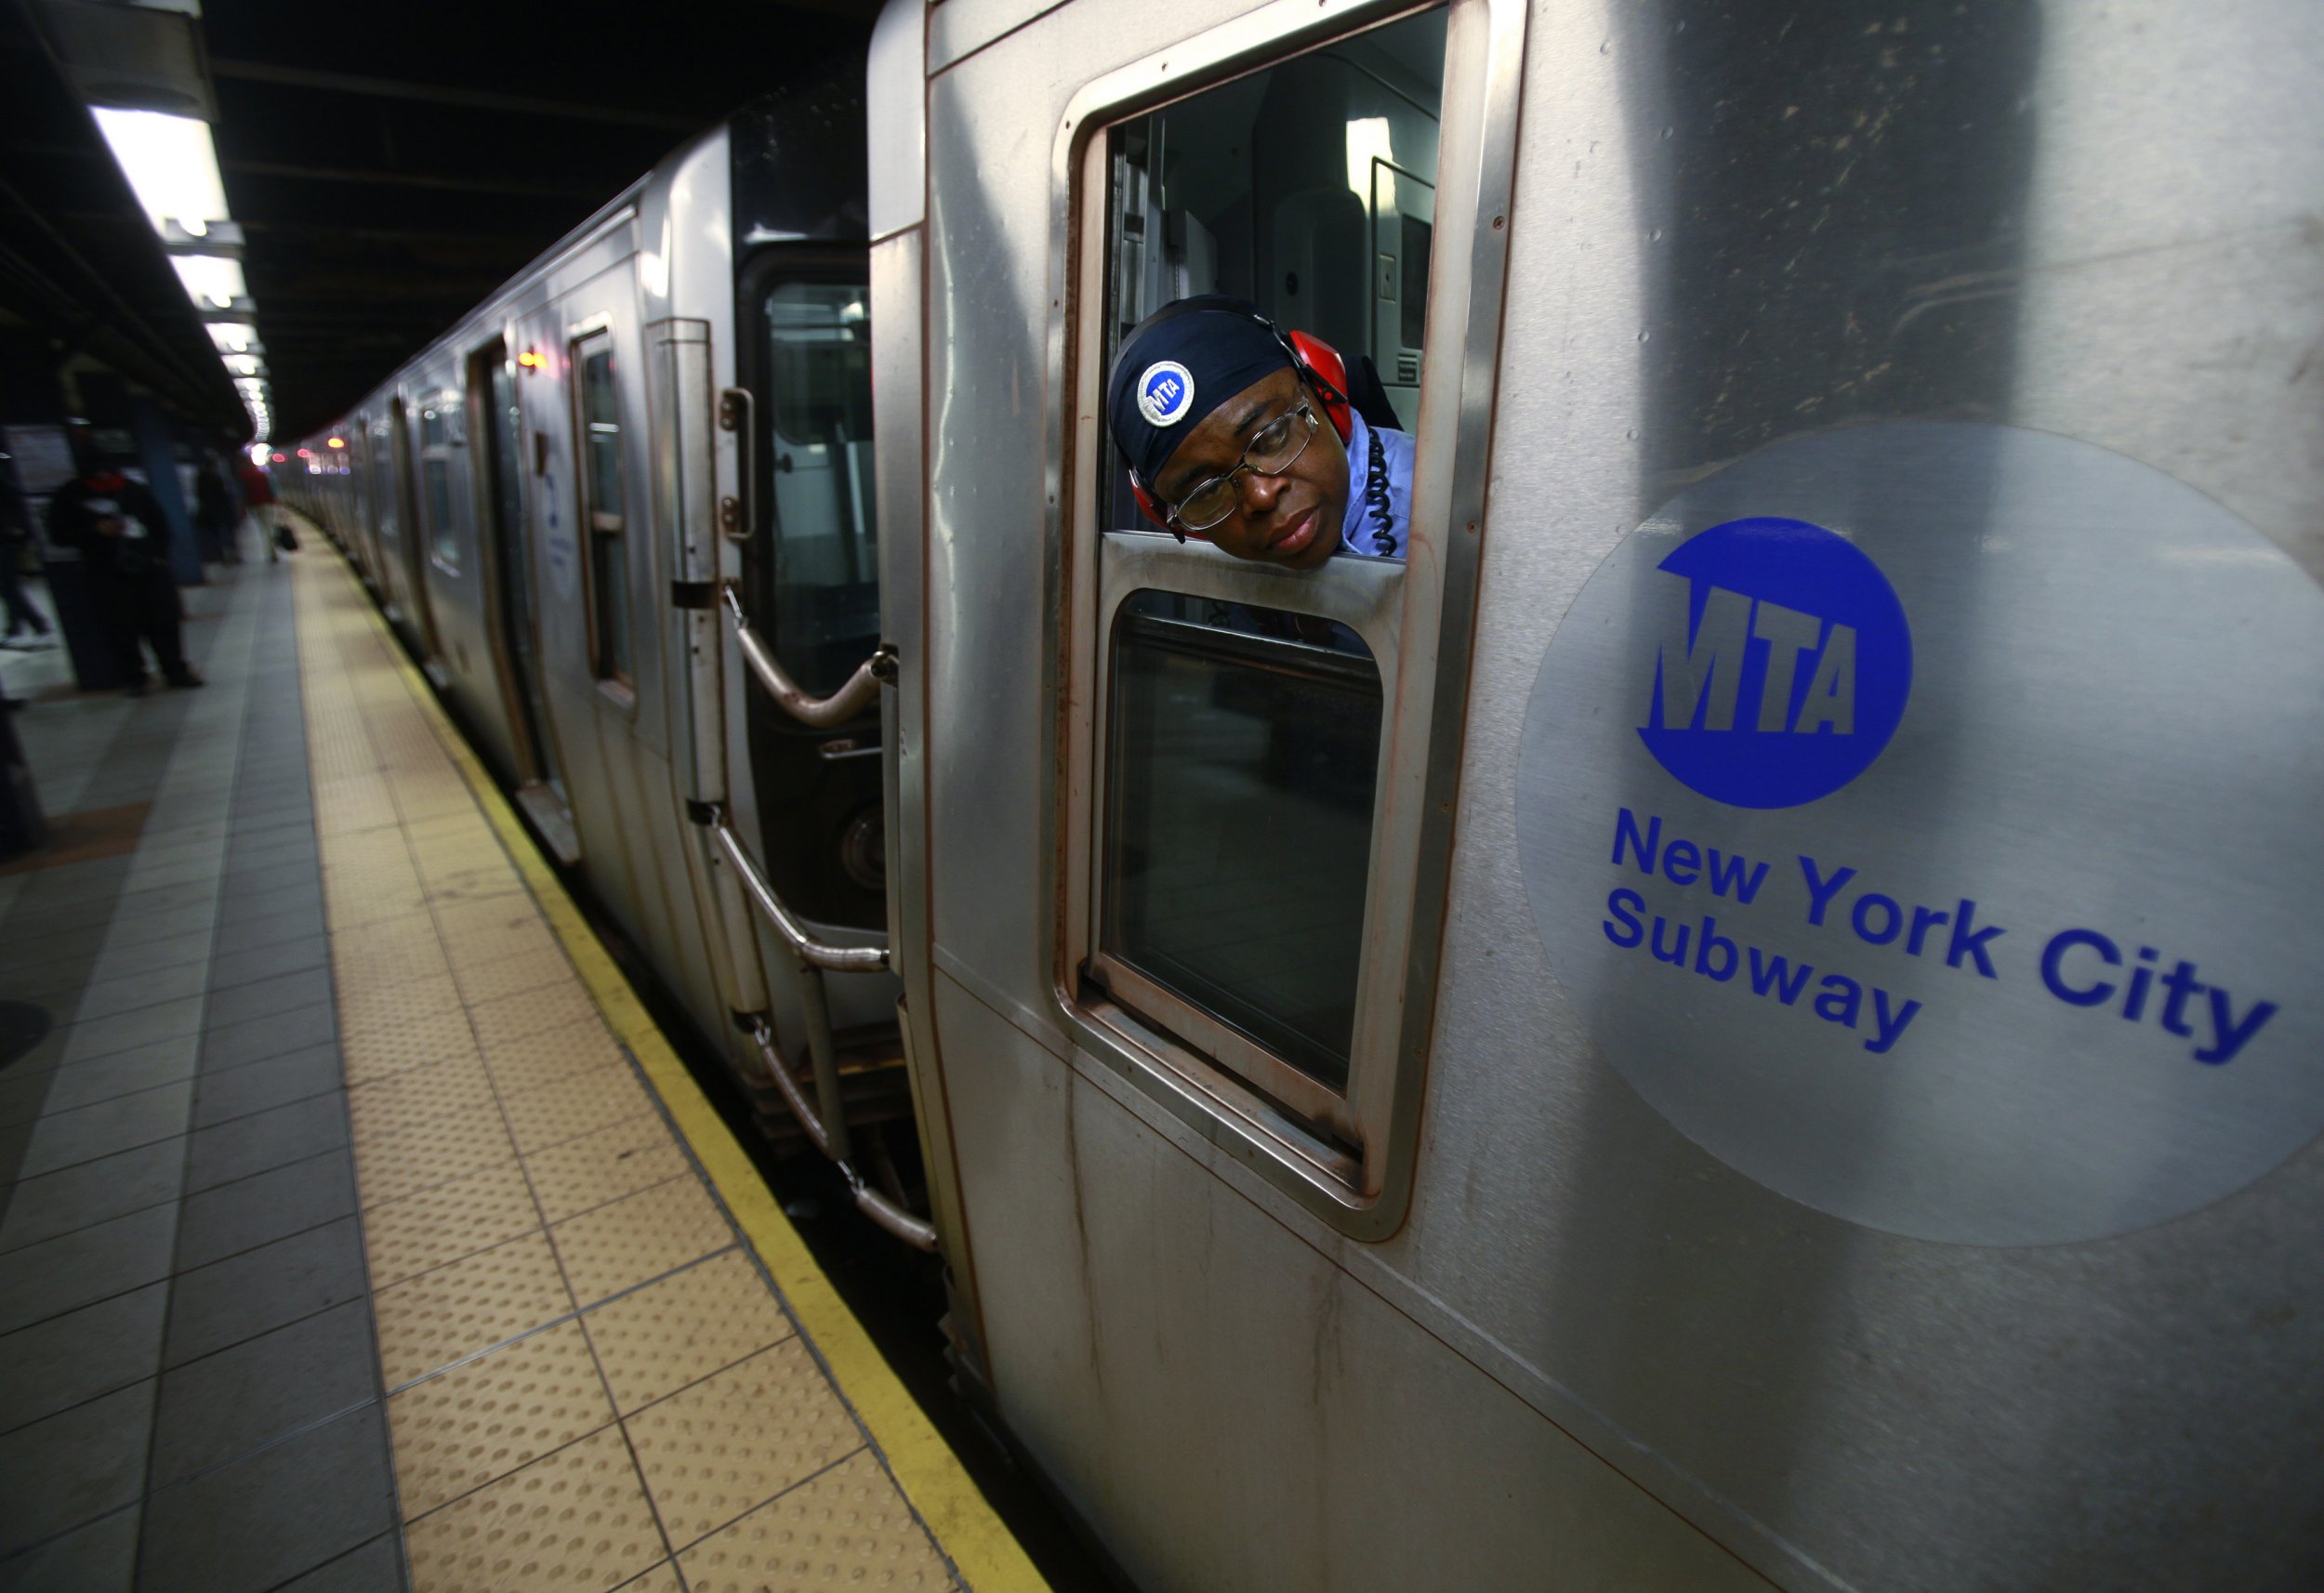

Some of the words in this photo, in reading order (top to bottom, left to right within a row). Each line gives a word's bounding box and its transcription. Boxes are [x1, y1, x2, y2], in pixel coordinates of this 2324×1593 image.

[1145, 378, 1181, 413] MTA
[1643, 570, 1858, 736] MTA
[1602, 887, 1922, 1055] Subway
[1610, 807, 1772, 905] New
[1798, 853, 2007, 981] York
[2040, 928, 2280, 1067] City
